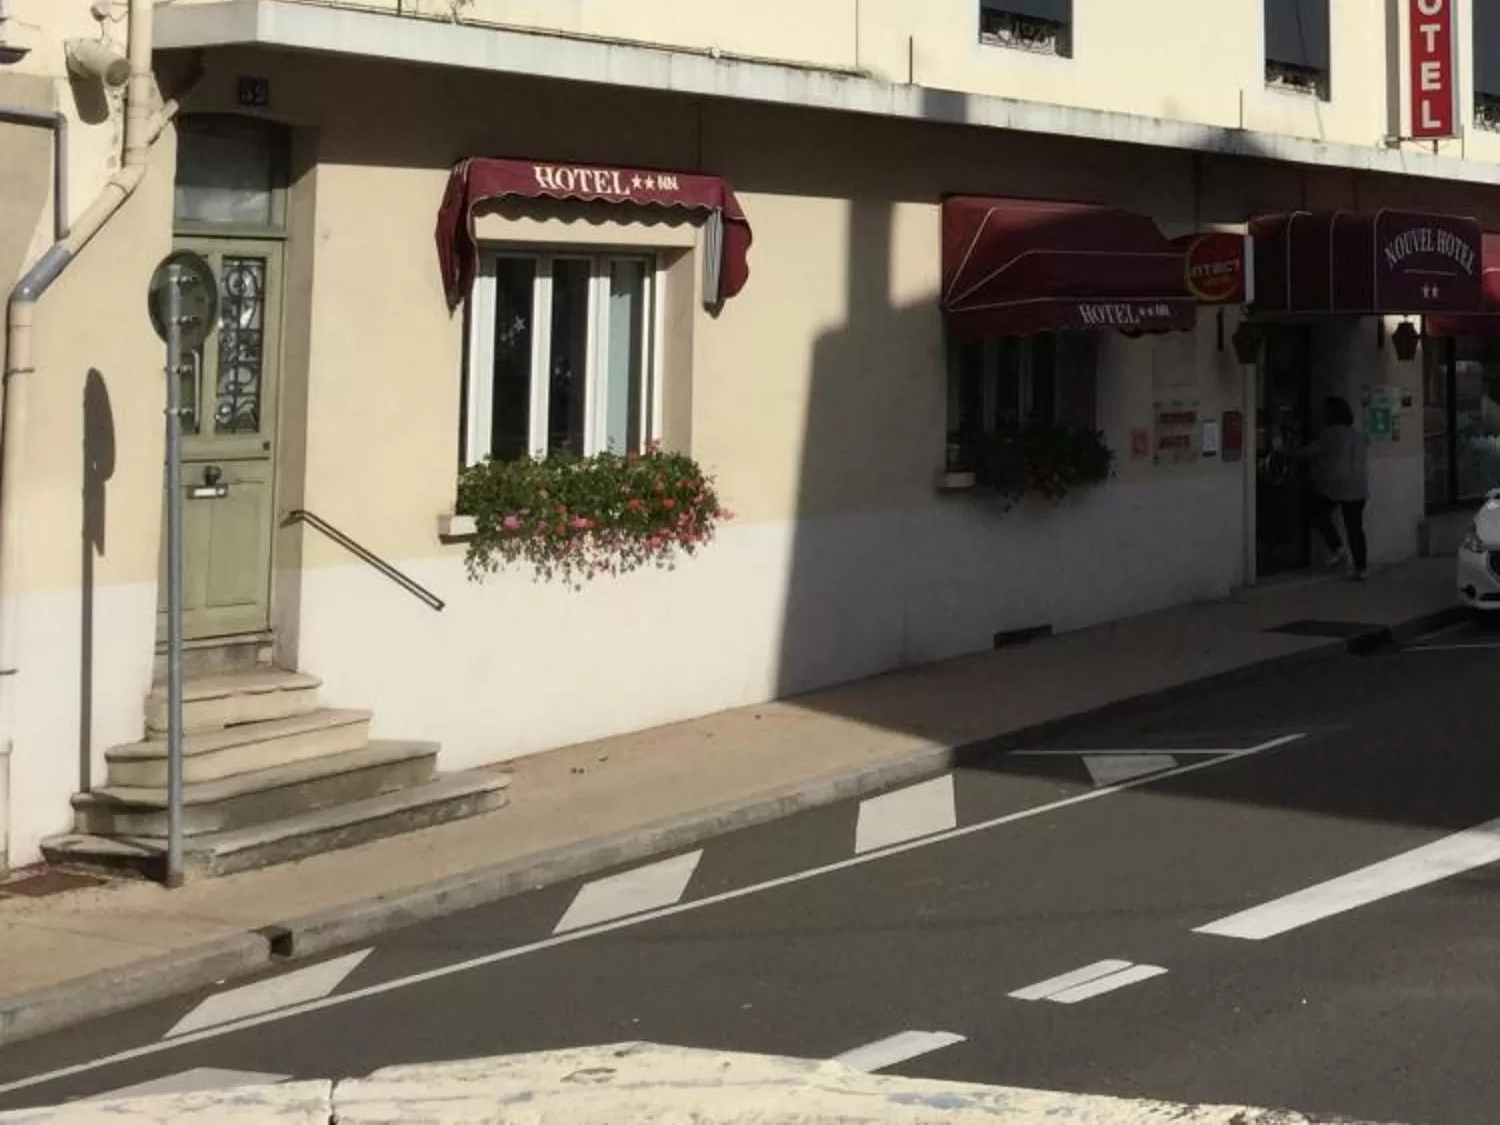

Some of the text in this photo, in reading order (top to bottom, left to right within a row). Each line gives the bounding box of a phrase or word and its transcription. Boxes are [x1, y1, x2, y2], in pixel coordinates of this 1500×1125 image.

[533, 165, 631, 196] HOTEL
[1384, 227, 1477, 276] NOUVEL HOTEL
[1078, 302, 1141, 324] HOTEL
